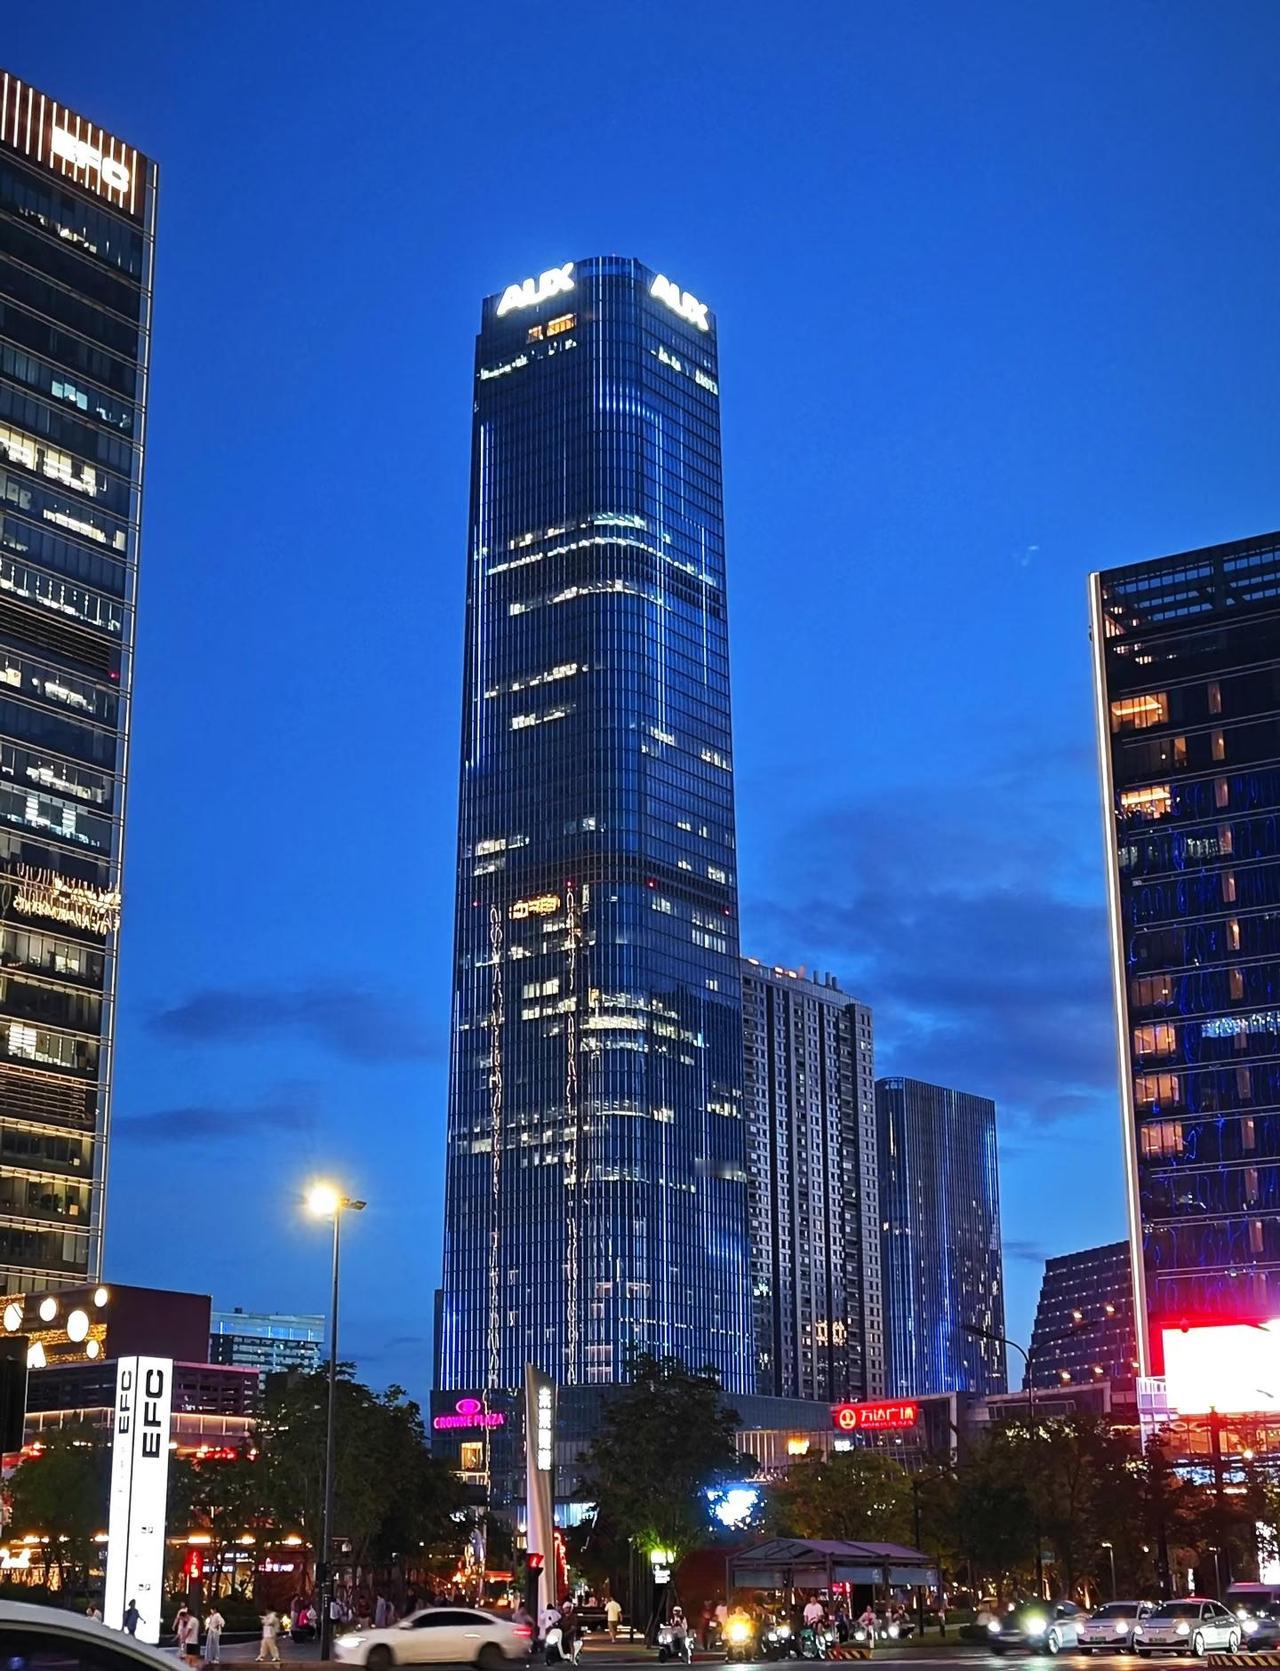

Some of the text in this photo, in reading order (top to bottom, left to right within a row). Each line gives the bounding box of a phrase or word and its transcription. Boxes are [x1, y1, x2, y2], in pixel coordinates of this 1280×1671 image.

[119, 1370, 132, 1434] EFC
[142, 1369, 164, 1458] EFC
[433, 1412, 504, 1430] CROWNE PLAZA
[861, 1407, 914, 1421] 万达广场
